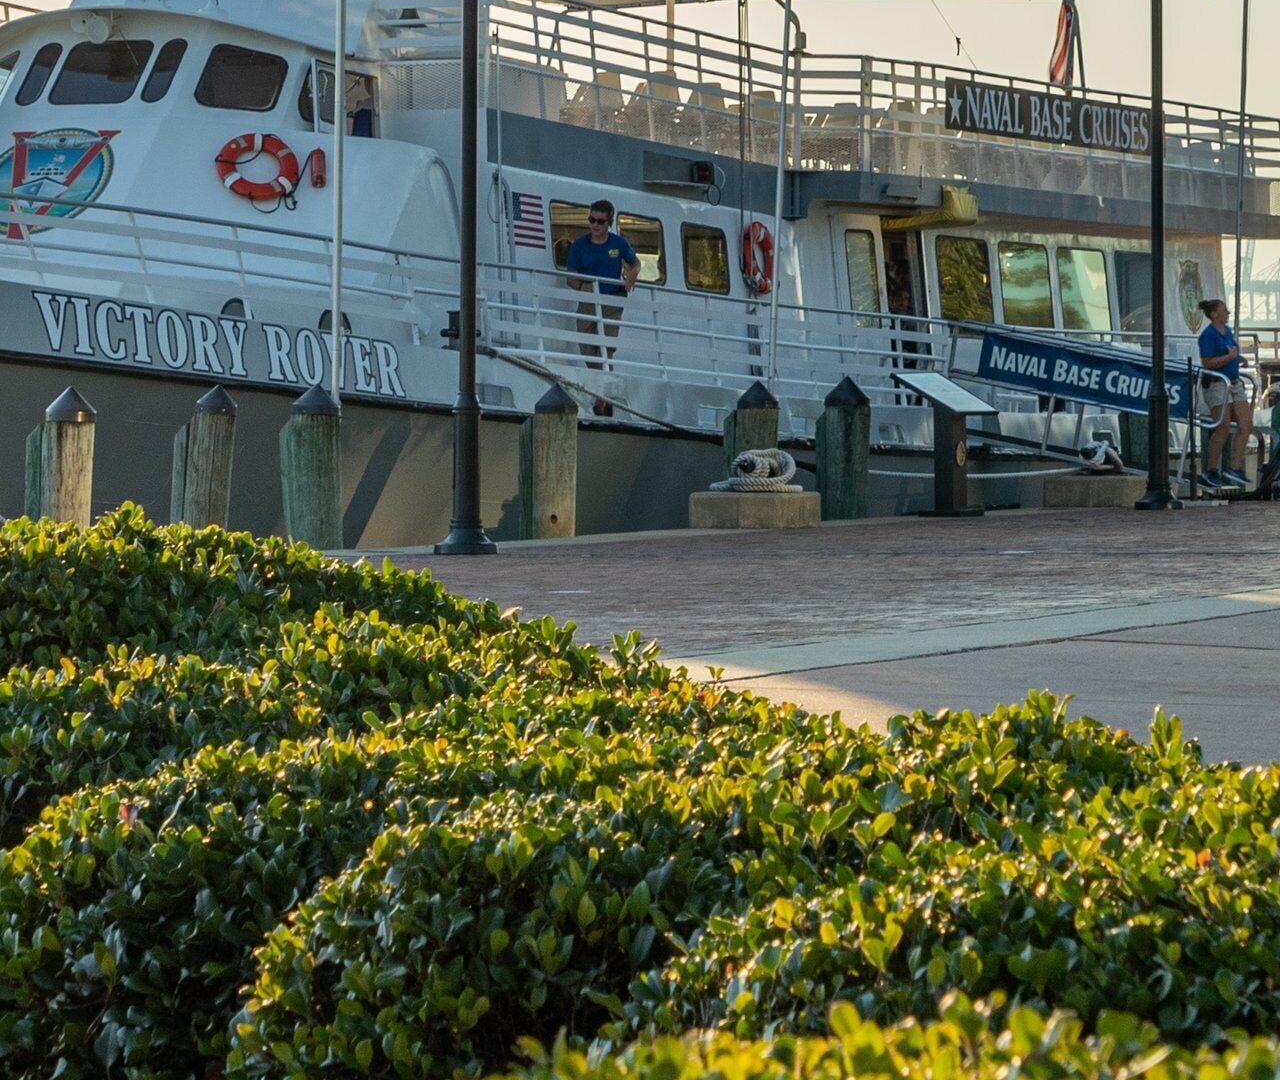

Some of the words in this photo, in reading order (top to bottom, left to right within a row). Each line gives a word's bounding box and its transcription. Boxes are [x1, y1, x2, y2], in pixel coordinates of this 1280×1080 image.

[964, 85, 1025, 134] NAVAL
[1029, 95, 1073, 141] BASE
[1078, 103, 1150, 152] CRUISES
[31, 290, 248, 377] VICTORY
[989, 345, 1048, 379] NAVAL
[1052, 359, 1100, 390] BASE
